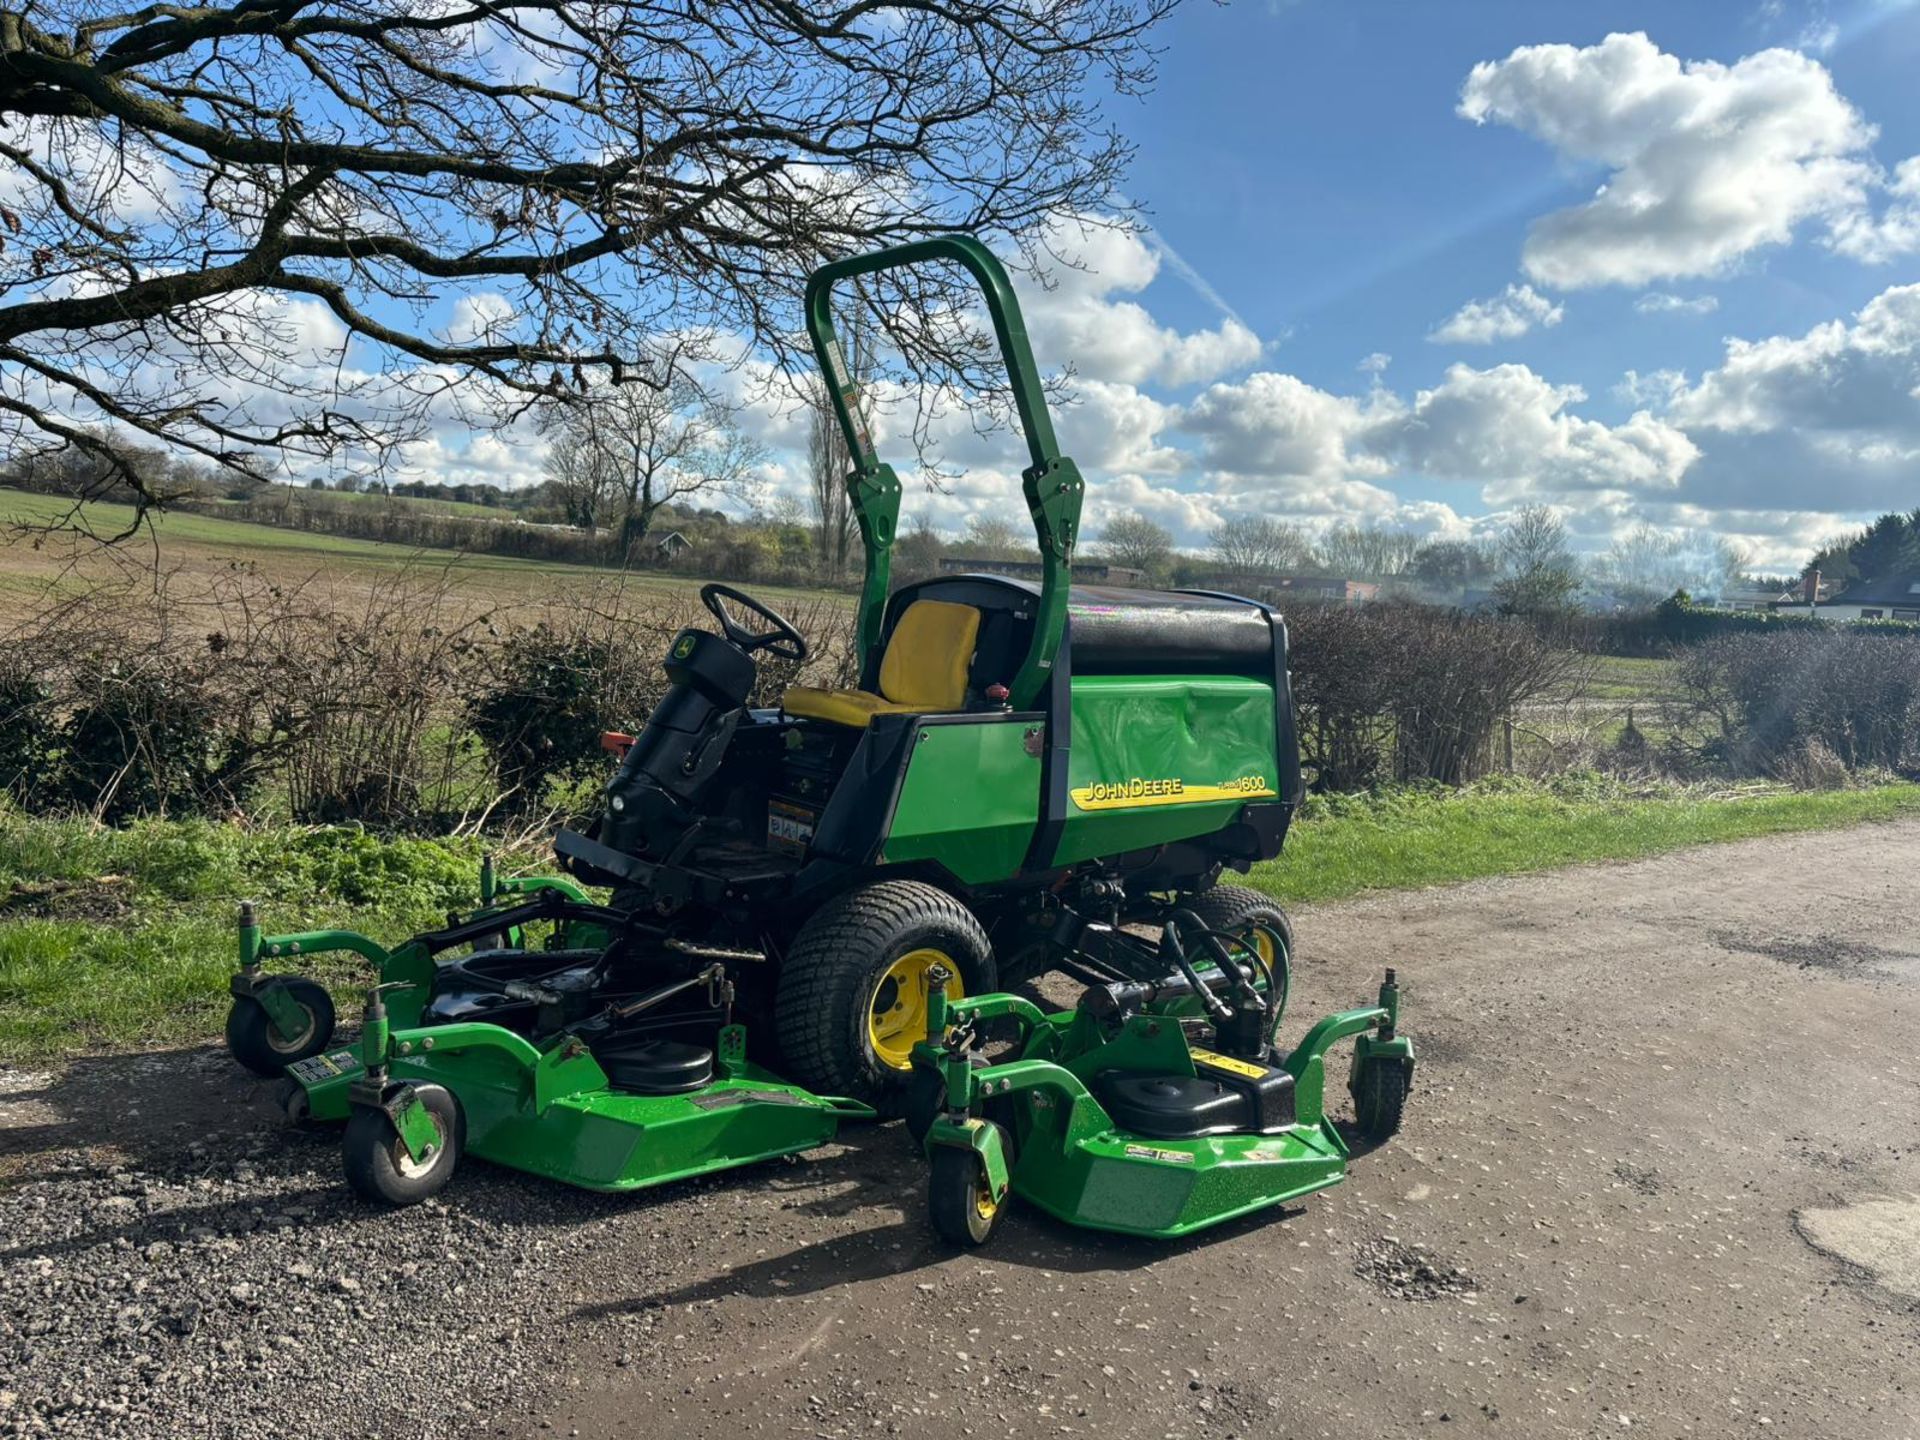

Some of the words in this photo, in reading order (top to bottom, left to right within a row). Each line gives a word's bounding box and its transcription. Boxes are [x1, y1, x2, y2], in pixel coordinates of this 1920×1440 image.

[1085, 781, 1129, 800] JOHN
[1131, 777, 1183, 796] DEERE
[1237, 776, 1265, 792] 1600
